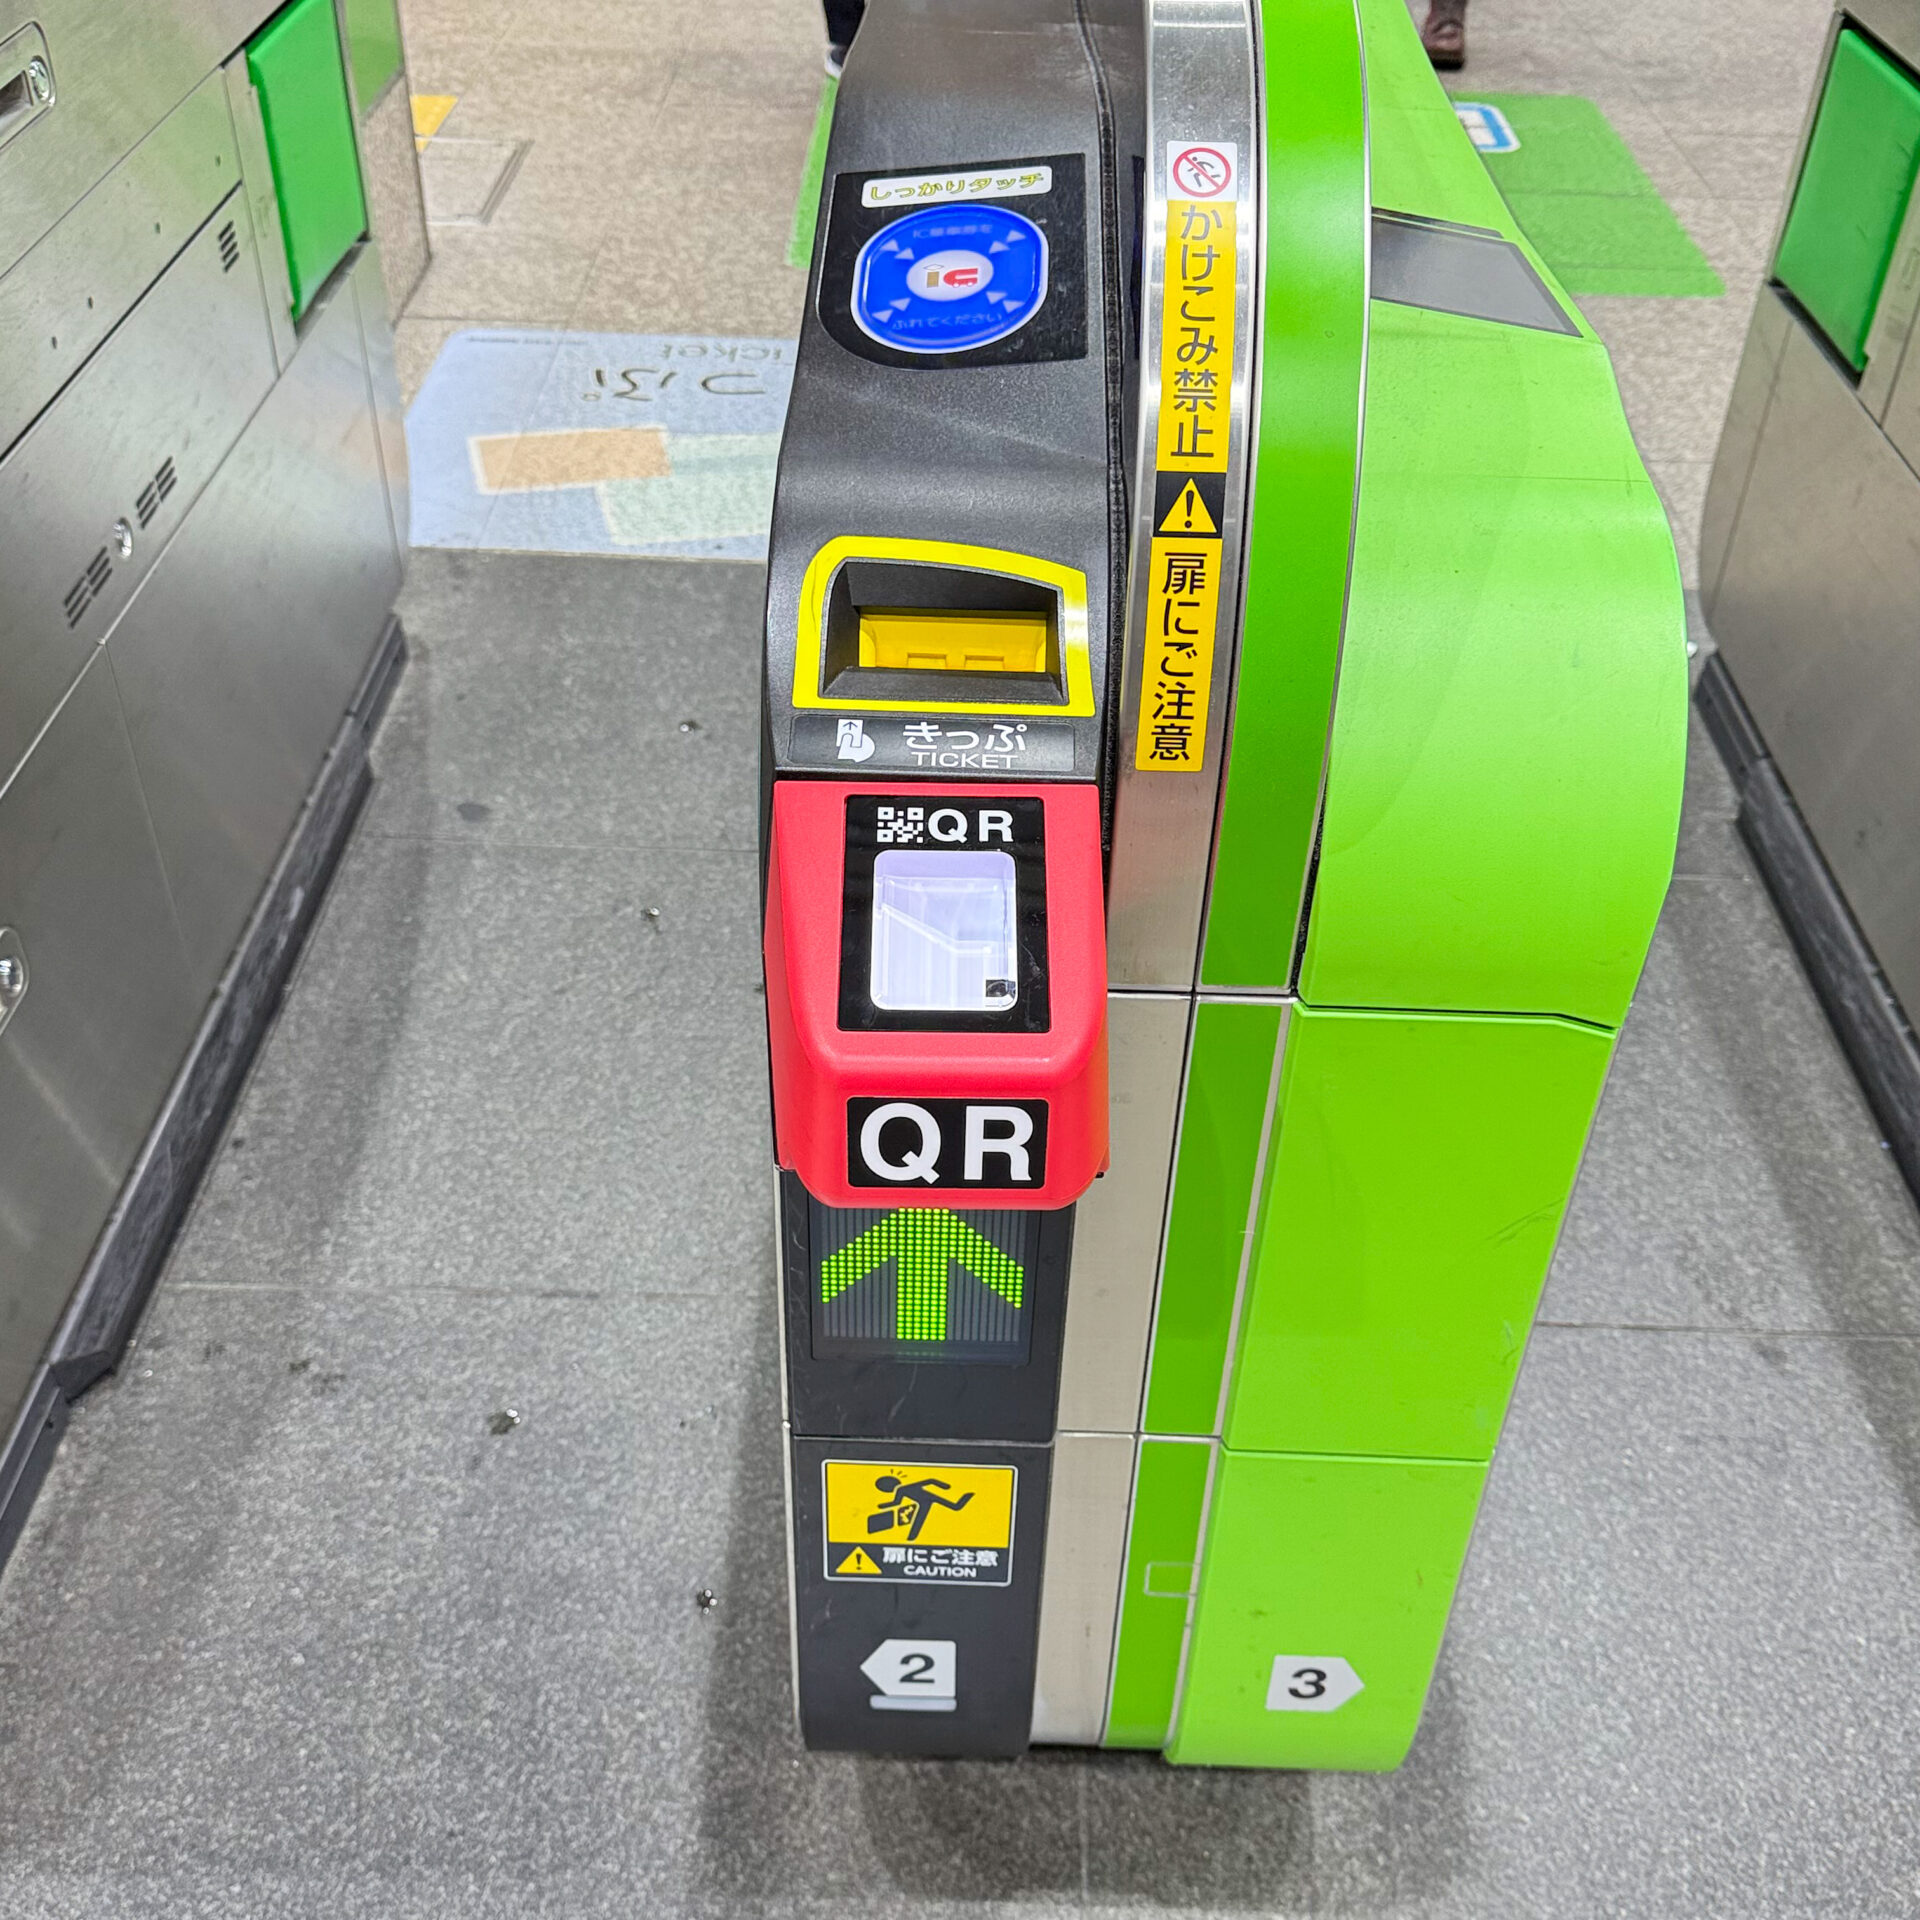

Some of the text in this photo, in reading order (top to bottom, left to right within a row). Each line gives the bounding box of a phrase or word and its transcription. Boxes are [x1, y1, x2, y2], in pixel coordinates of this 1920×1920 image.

[869, 173, 1044, 200] しっかりタッチ
[1170, 204, 1223, 458] かけこみ禁止
[660, 343, 792, 365] icket
[1149, 551, 1208, 761] 扉にご注意
[902, 721, 1028, 752] きっぷ
[910, 752, 1018, 769] TICKET
[927, 808, 1014, 844] QR
[859, 1102, 1034, 1185] QR
[882, 1546, 999, 1567] 扉にご注意
[903, 1564, 977, 1578] CAUTION
[899, 1653, 935, 1684] 2
[1287, 1668, 1327, 1698] 3
